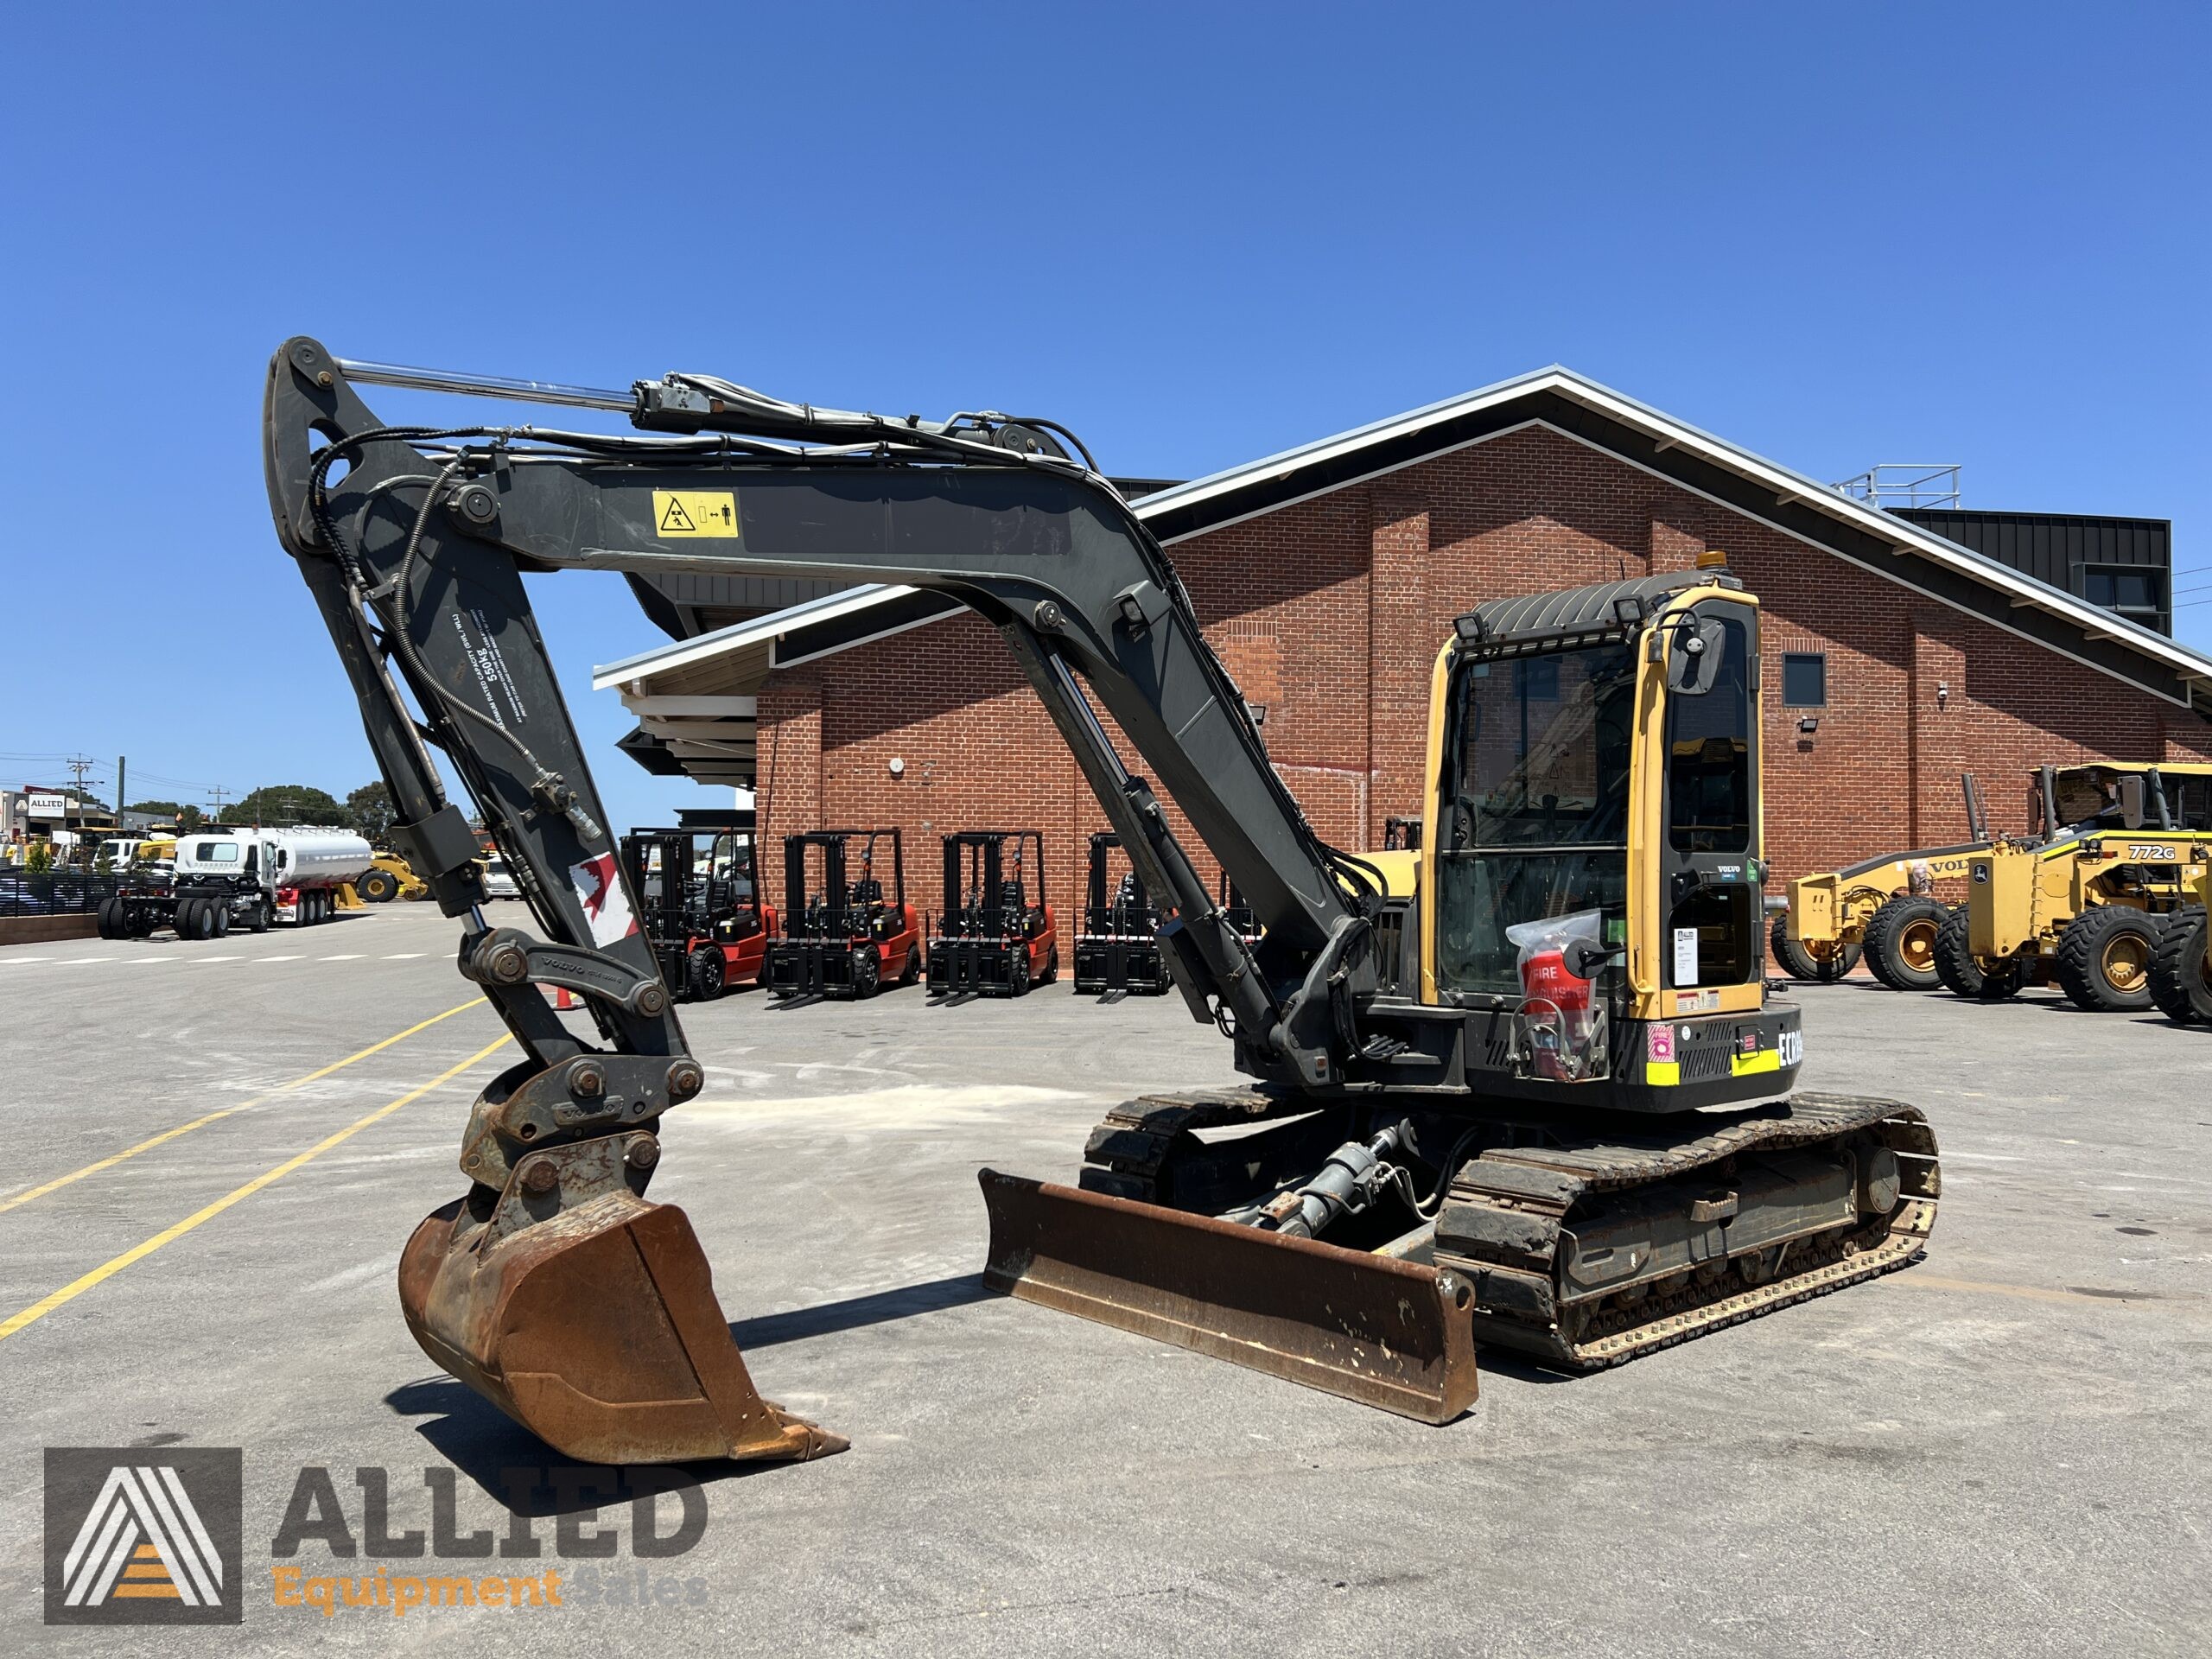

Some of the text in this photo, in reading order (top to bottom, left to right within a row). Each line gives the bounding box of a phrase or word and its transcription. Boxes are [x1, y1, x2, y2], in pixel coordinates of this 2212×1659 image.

[451, 612, 463, 629] WLL)
[459, 632, 472, 649] (SWL
[467, 648, 484, 680] CAPACITY
[475, 648, 498, 683] 550kg
[498, 658, 508, 673] CHART
[496, 669, 505, 682] OVER
[480, 679, 493, 702] RATED
[501, 681, 512, 697] REACH
[508, 696, 519, 717] MAXIMUM
[2128, 844, 2175, 860] 772G
[1929, 859, 1969, 873] VOL
[541, 956, 585, 975] VOLVO
[1532, 967, 1558, 980] FIRE
